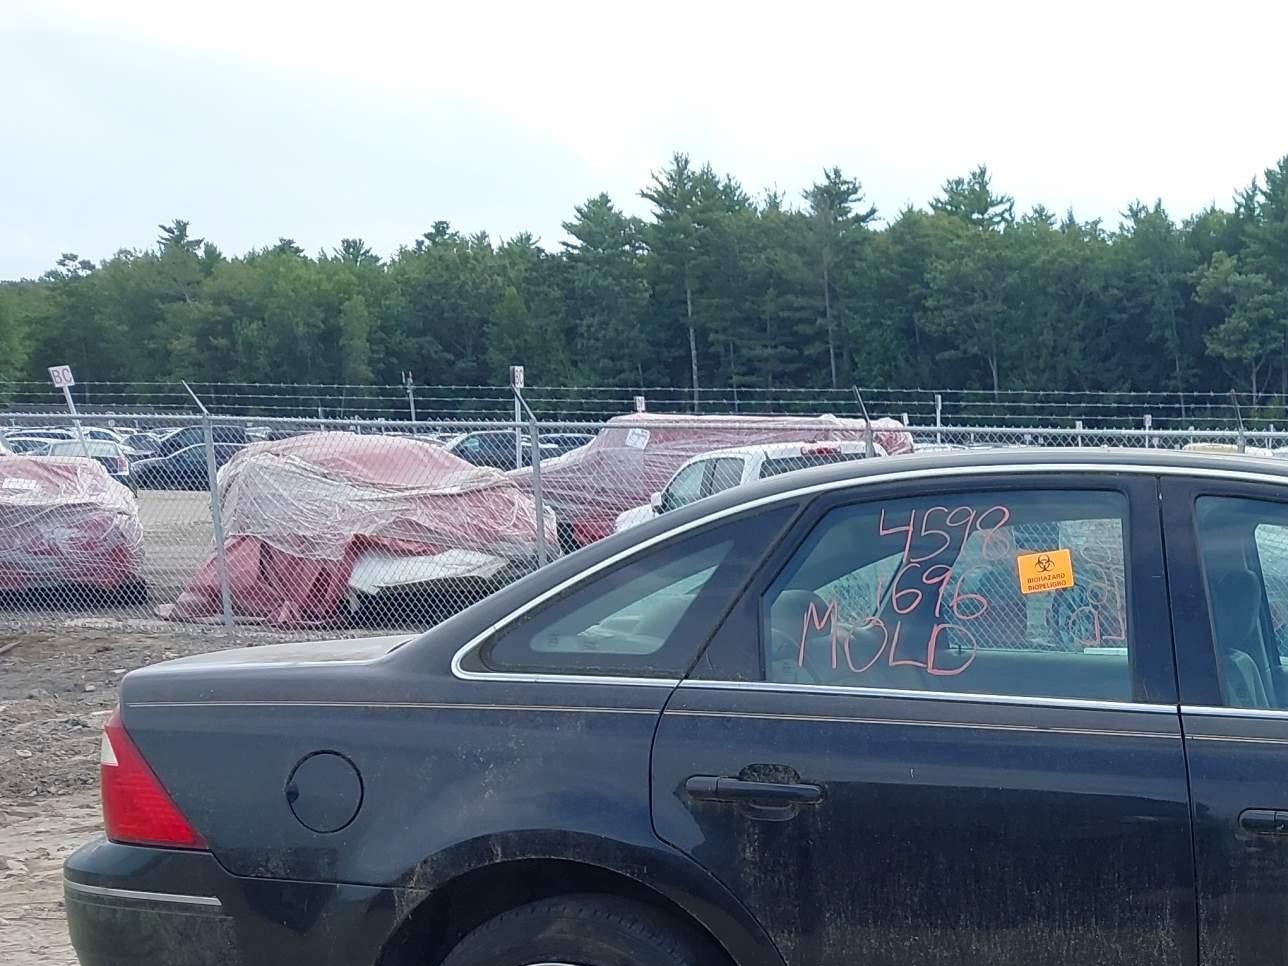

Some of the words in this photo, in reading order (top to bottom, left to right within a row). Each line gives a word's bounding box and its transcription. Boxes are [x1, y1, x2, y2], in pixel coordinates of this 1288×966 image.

[52, 368, 71, 384] BC
[1027, 573, 1066, 584] BIOHAZARD
[1028, 580, 1067, 590] BIOPELIGRO
[799, 598, 977, 676] MOLD
